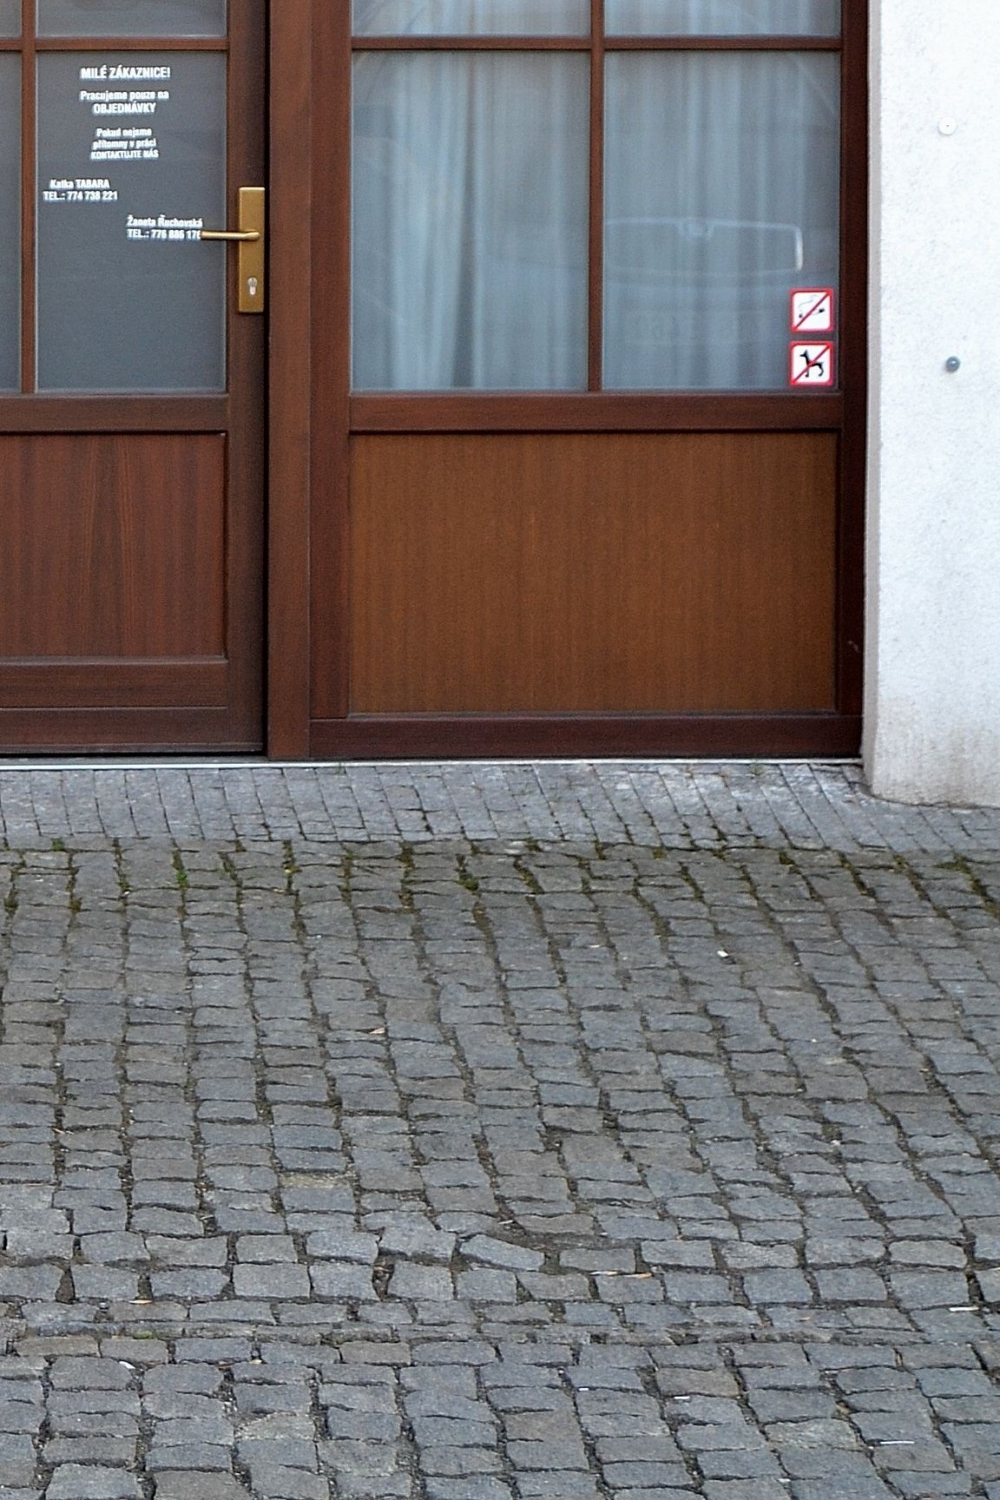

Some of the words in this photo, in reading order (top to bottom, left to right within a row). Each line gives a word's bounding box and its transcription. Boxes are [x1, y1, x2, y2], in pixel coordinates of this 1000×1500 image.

[81, 65, 108, 79] MILÉ
[109, 64, 171, 79] ZÁKAZNICE!
[80, 90, 128, 102] Pracujeme
[129, 91, 156, 102] pouze
[157, 90, 169, 100] na
[93, 101, 157, 114] OBJEDNÁVKY
[50, 178, 74, 190] Katka
[75, 178, 110, 190] TABARA
[42, 191, 66, 201] TEL.:
[66, 191, 83, 201] 774
[102, 190, 118, 201] 221
[126, 214, 156, 227] Žaneta
[127, 228, 150, 239] TEL.:
